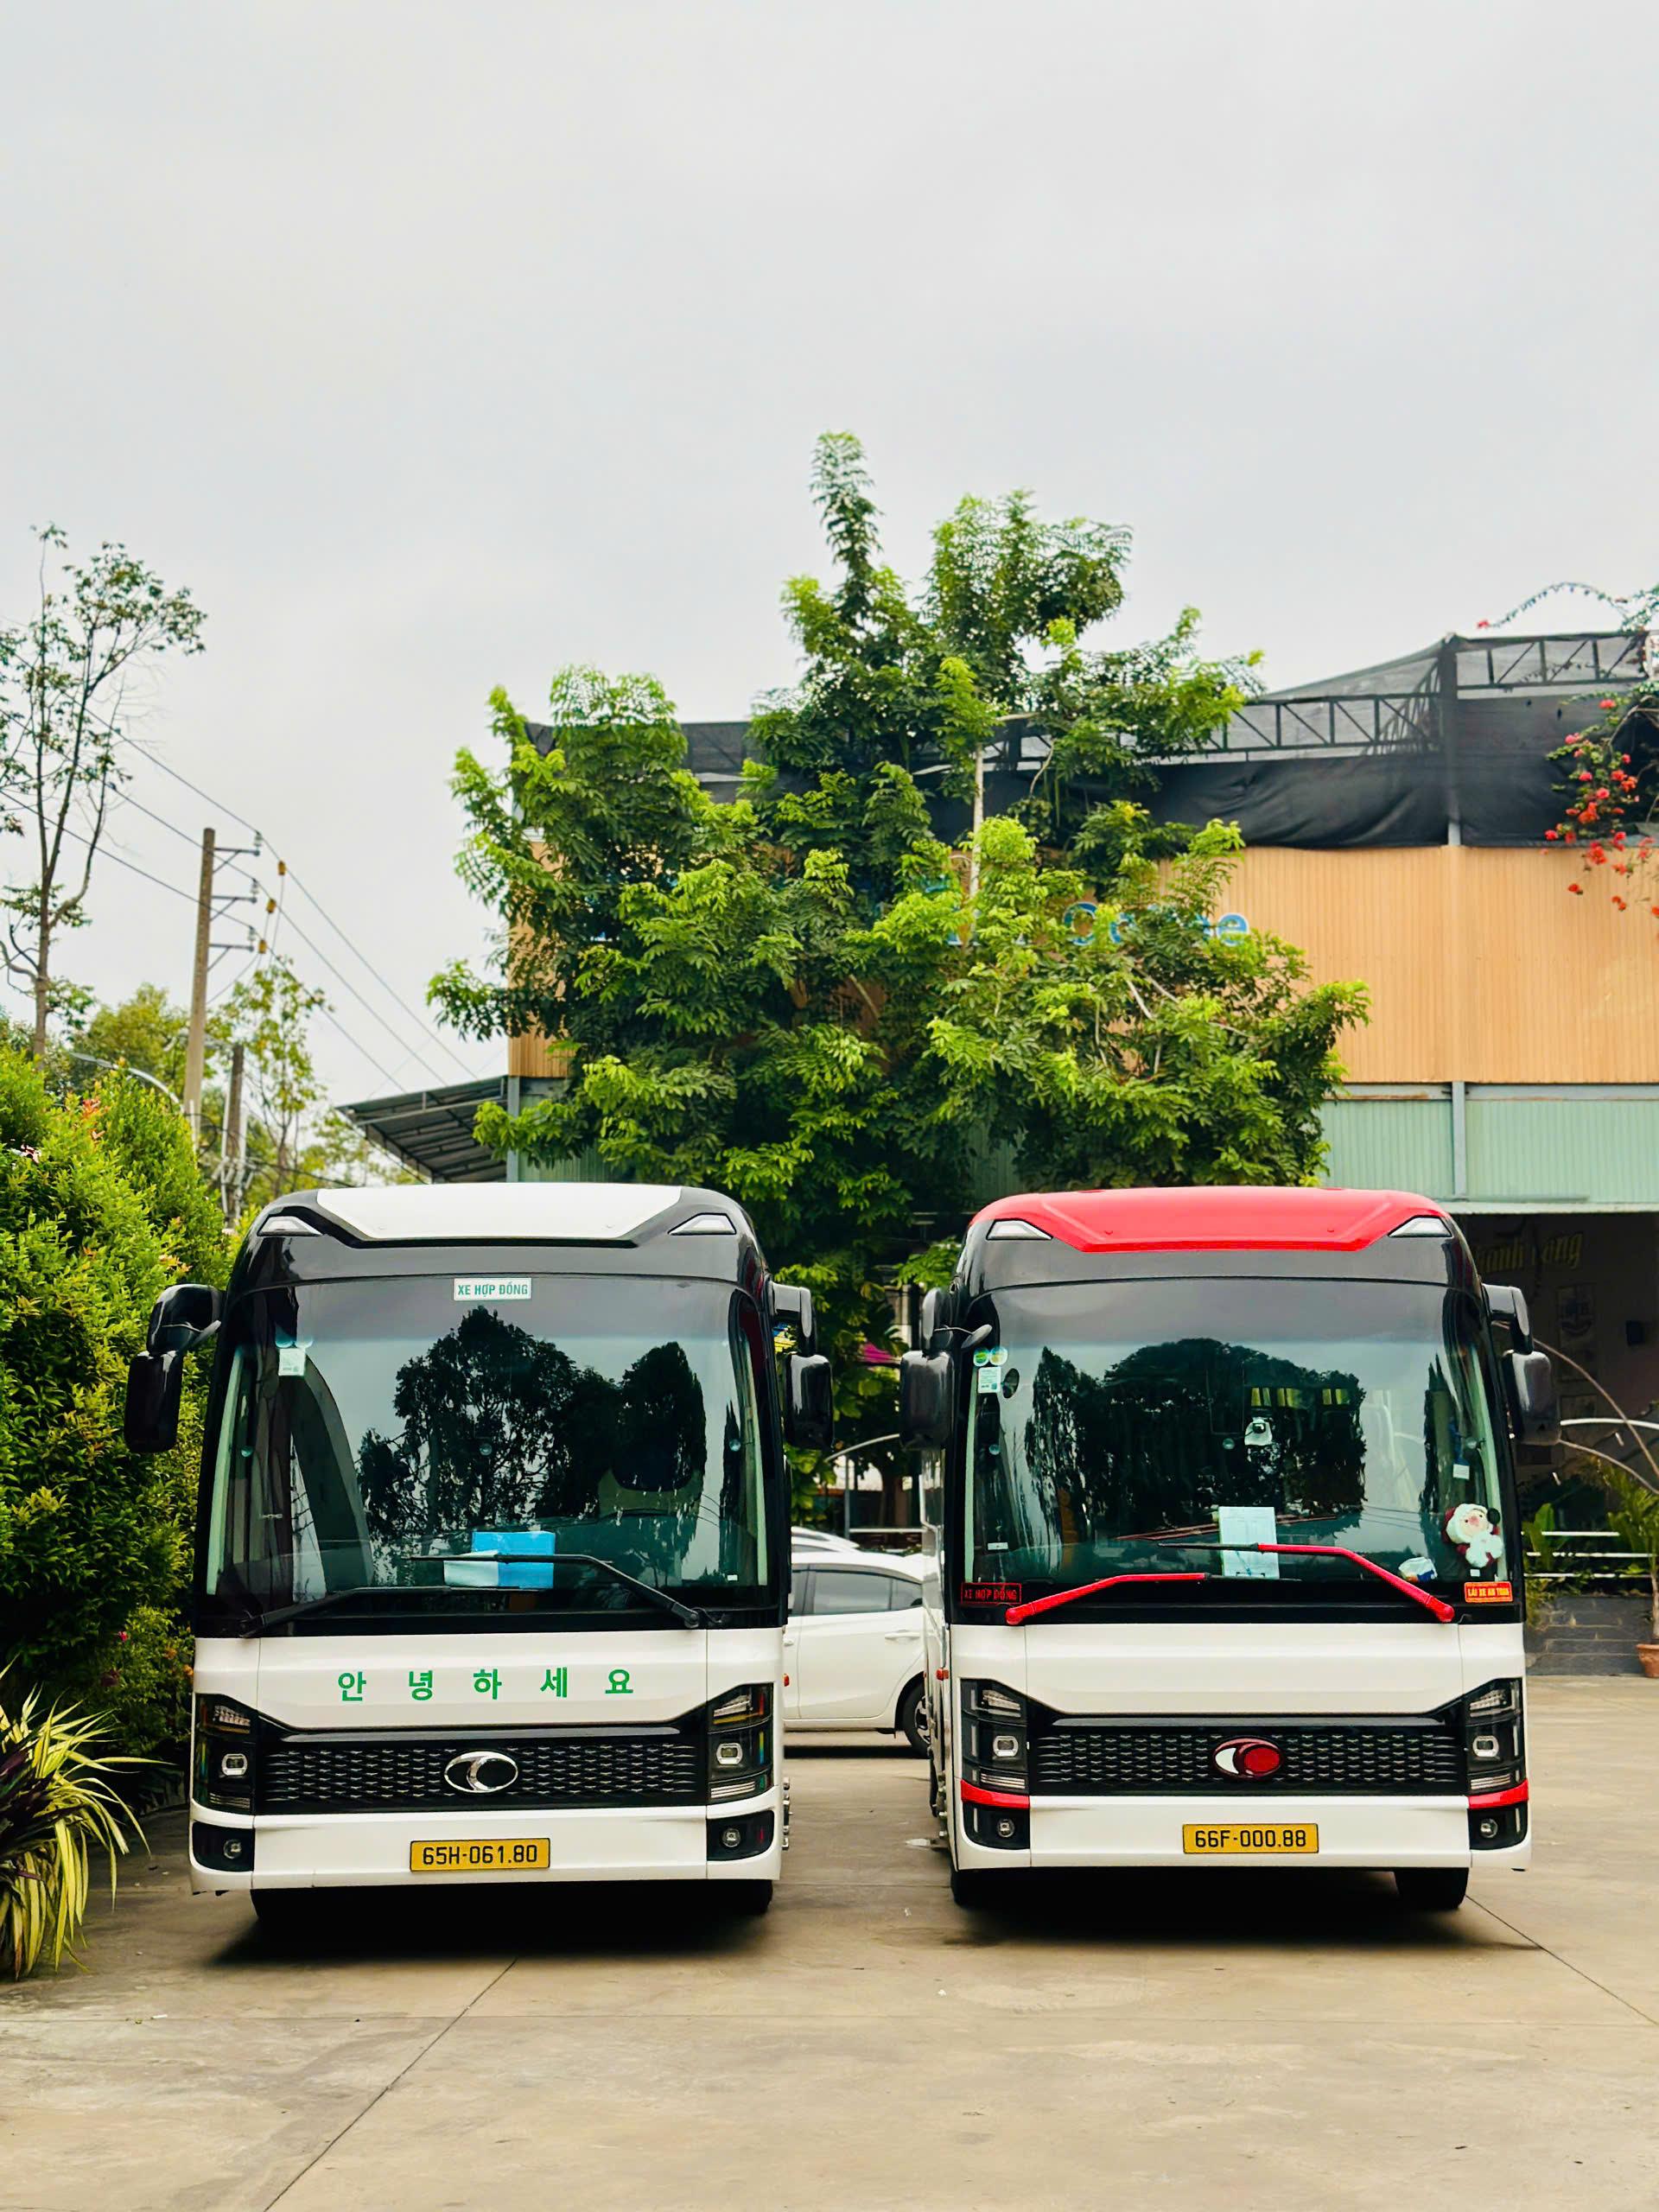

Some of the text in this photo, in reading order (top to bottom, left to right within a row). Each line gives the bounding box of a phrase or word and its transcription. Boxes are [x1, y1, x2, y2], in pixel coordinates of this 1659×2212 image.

[458, 1285, 471, 1295] XE
[474, 1283, 496, 1297] HỢP
[1195, 1829, 1306, 1847] 66F-000.88
[423, 1845, 537, 1865] 65H-061.80
